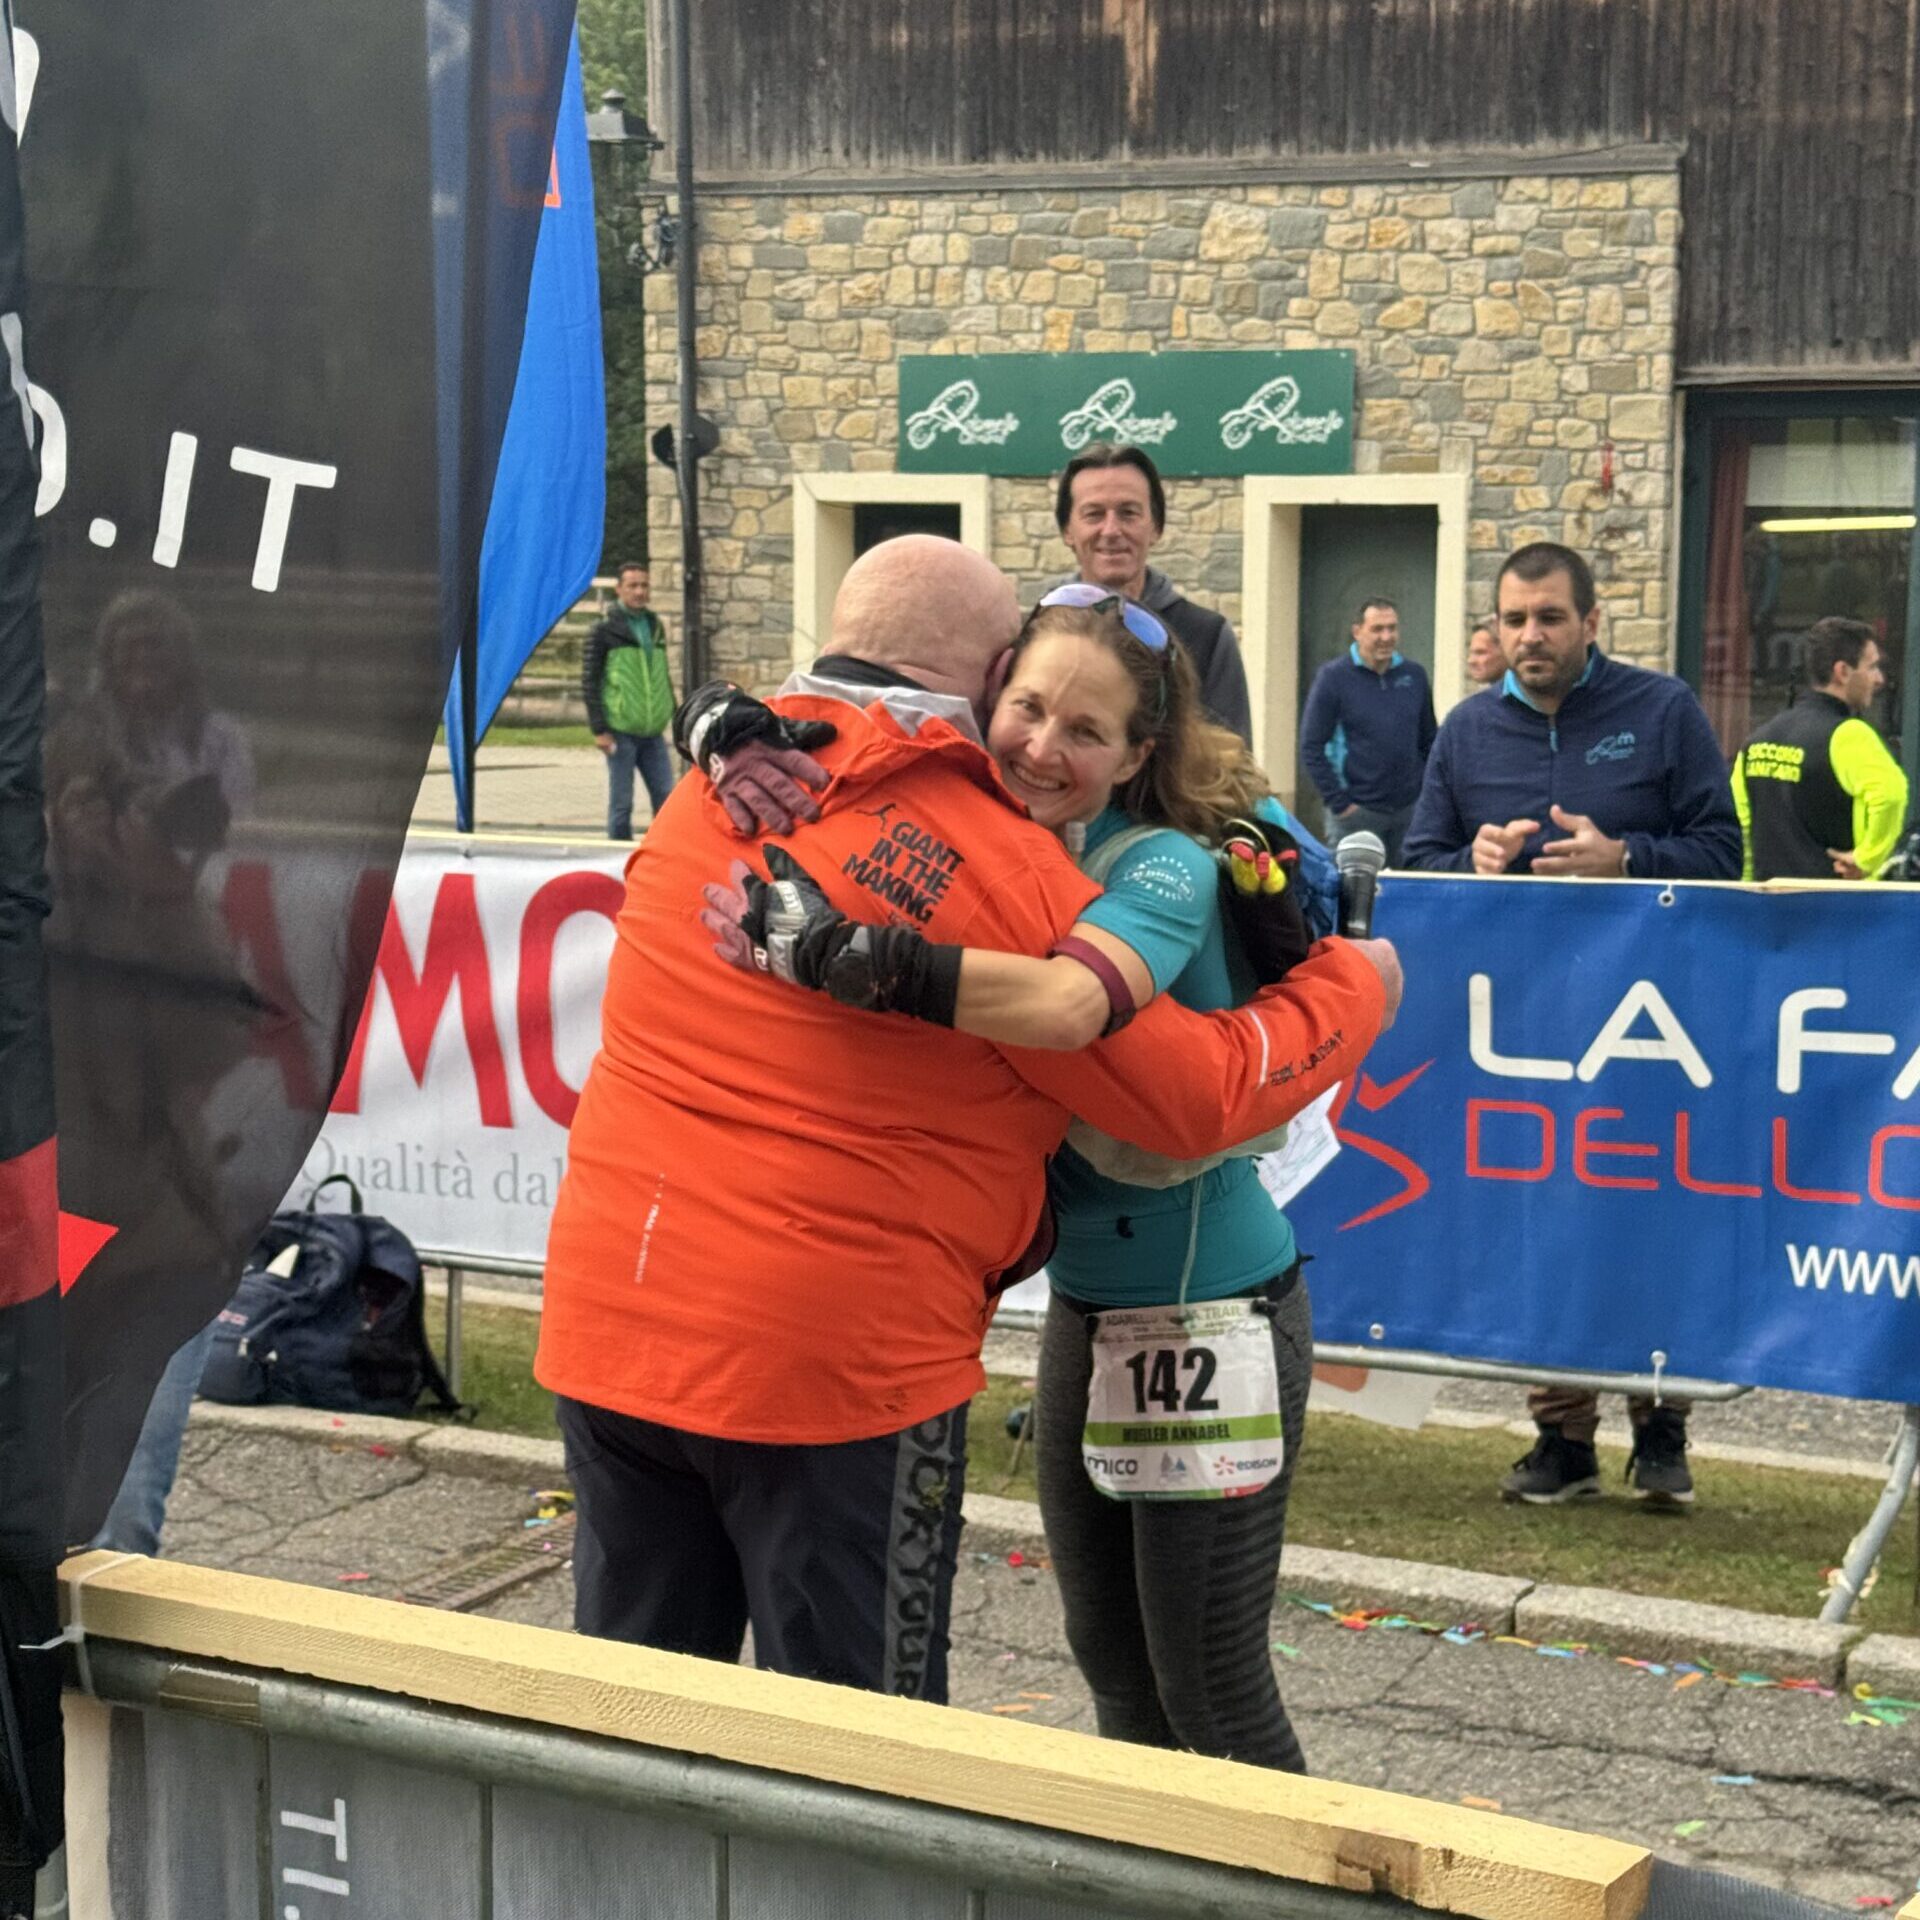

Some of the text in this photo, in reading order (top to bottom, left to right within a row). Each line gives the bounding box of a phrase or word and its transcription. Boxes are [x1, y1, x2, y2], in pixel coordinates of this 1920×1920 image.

[869, 838, 954, 900] IN THE
[891, 821, 966, 874] GIANT
[842, 854, 938, 924] MAKING
[1468, 973, 1713, 1088] LA
[1777, 988, 1920, 1100] F
[1126, 1347, 1219, 1414] 142
[1171, 1422, 1231, 1442] ANNABEL
